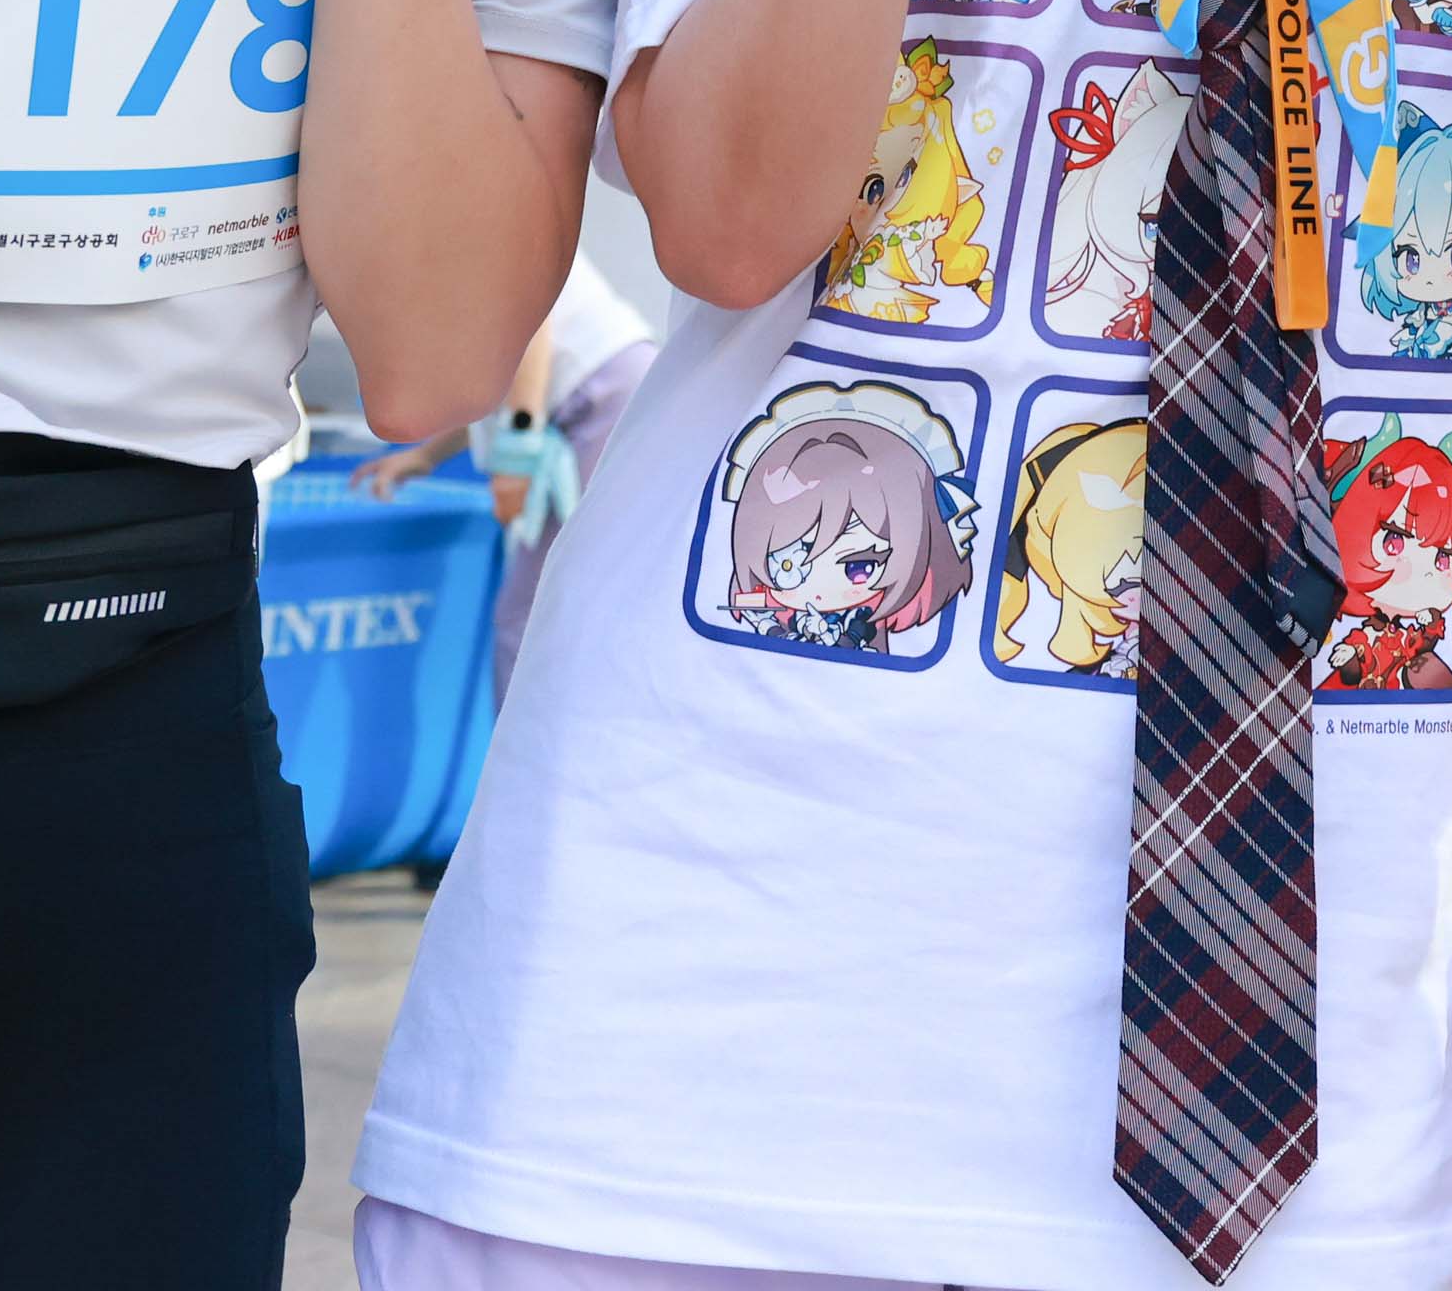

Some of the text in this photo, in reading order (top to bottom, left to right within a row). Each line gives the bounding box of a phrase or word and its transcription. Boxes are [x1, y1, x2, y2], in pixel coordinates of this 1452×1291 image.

[1284, 148, 1317, 236] LINE
[169, 225, 200, 242] 구로구
[207, 213, 270, 236] netmarble
[261, 592, 436, 658] INTEX
[1325, 719, 1335, 735] &
[1340, 719, 1410, 735] Netmarble
